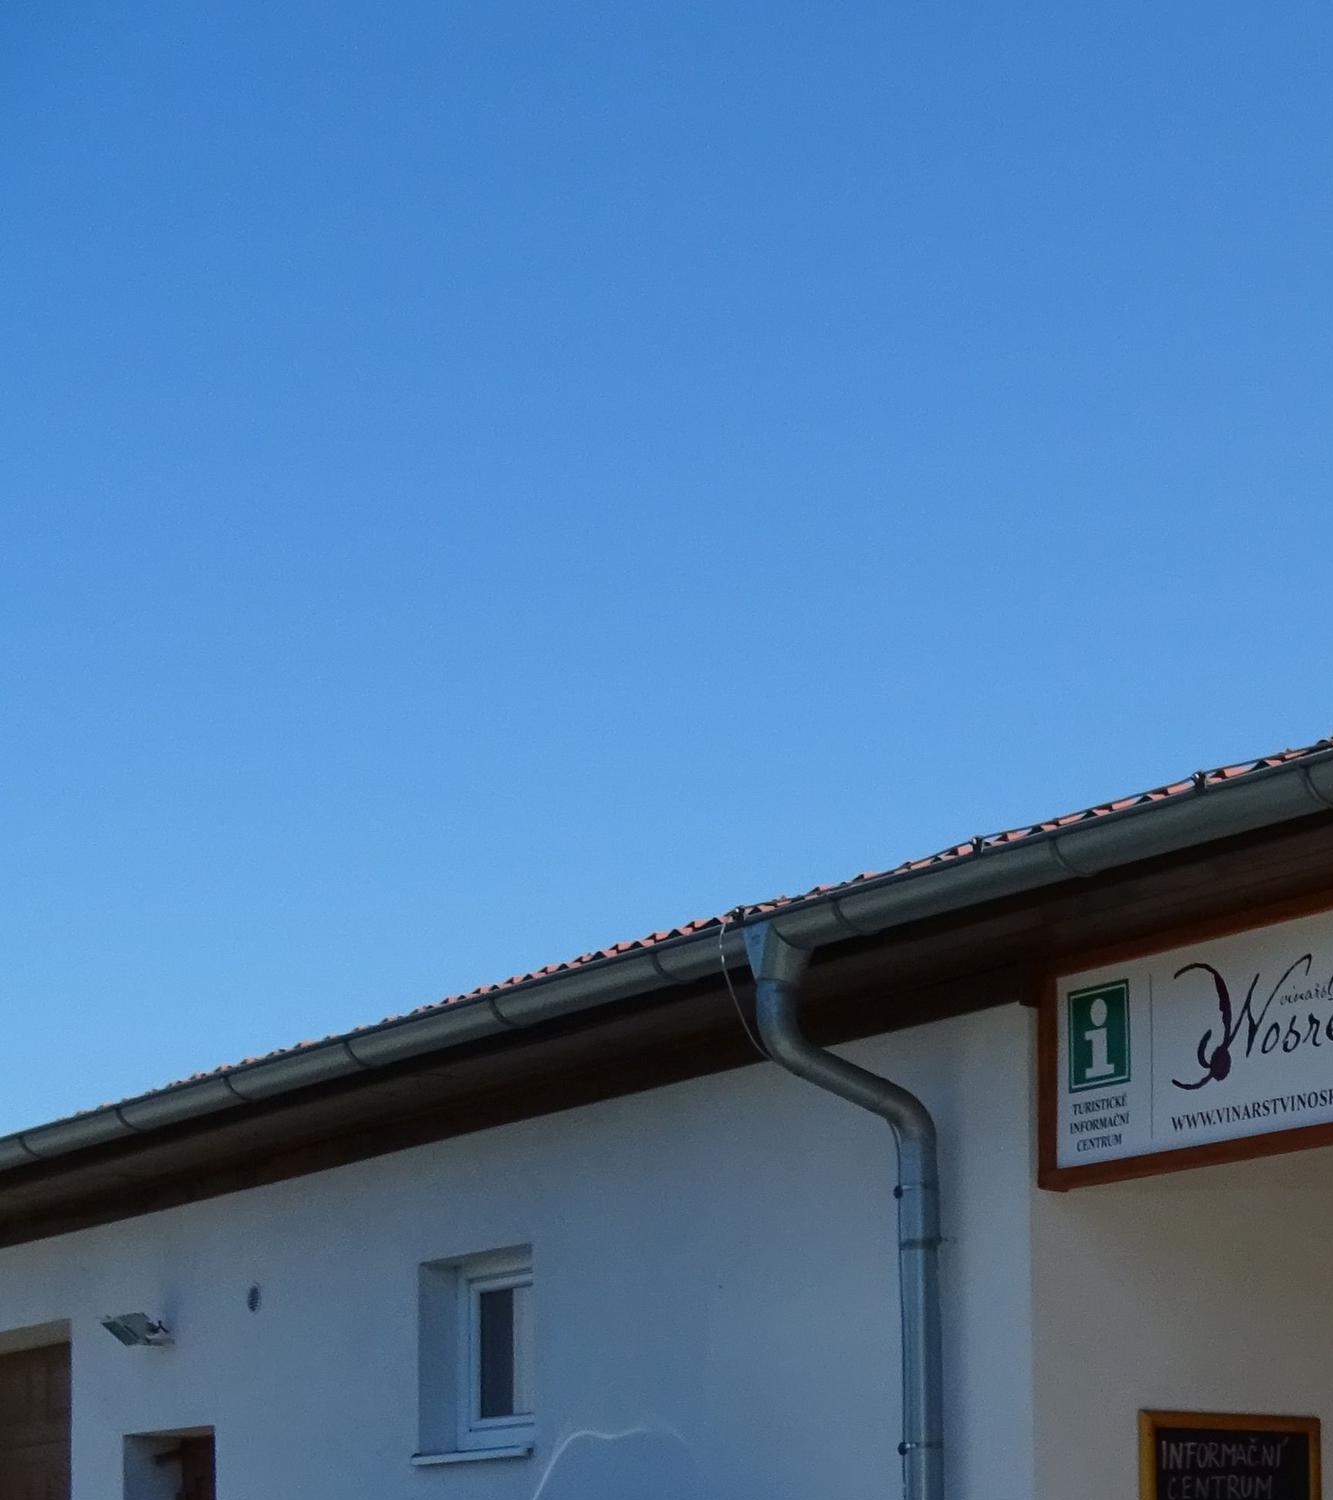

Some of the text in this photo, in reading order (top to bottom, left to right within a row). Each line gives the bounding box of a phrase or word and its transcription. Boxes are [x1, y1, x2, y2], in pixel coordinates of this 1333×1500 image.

[1072, 1093, 1129, 1116] TURISTICKÉ
[1069, 1111, 1131, 1134] INFORMAČNÍ
[1076, 1133, 1123, 1153] CENTRUM
[1160, 1434, 1289, 1470] INFORMAČNÍ
[1167, 1475, 1273, 1500] CENTRUM
